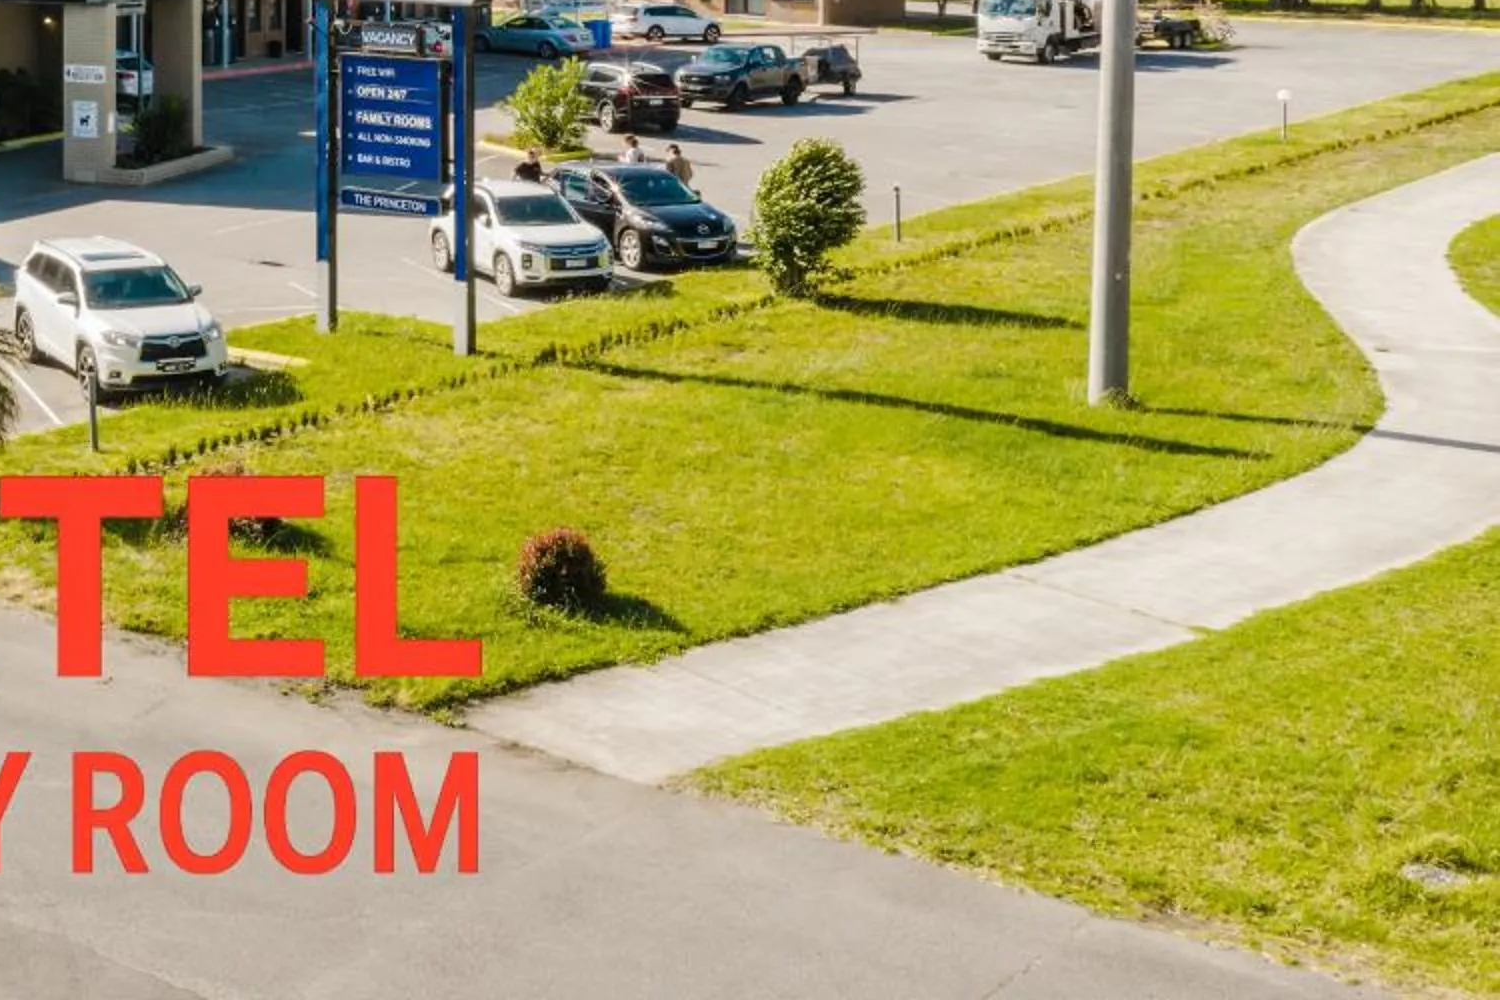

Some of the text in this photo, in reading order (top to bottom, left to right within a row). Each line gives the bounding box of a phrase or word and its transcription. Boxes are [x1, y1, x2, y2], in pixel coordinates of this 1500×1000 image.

[361, 30, 417, 45] VACANCY
[357, 86, 385, 99] OPEN
[356, 110, 432, 131] FAMILY ROOMS
[354, 194, 427, 212] THE PRINCETON
